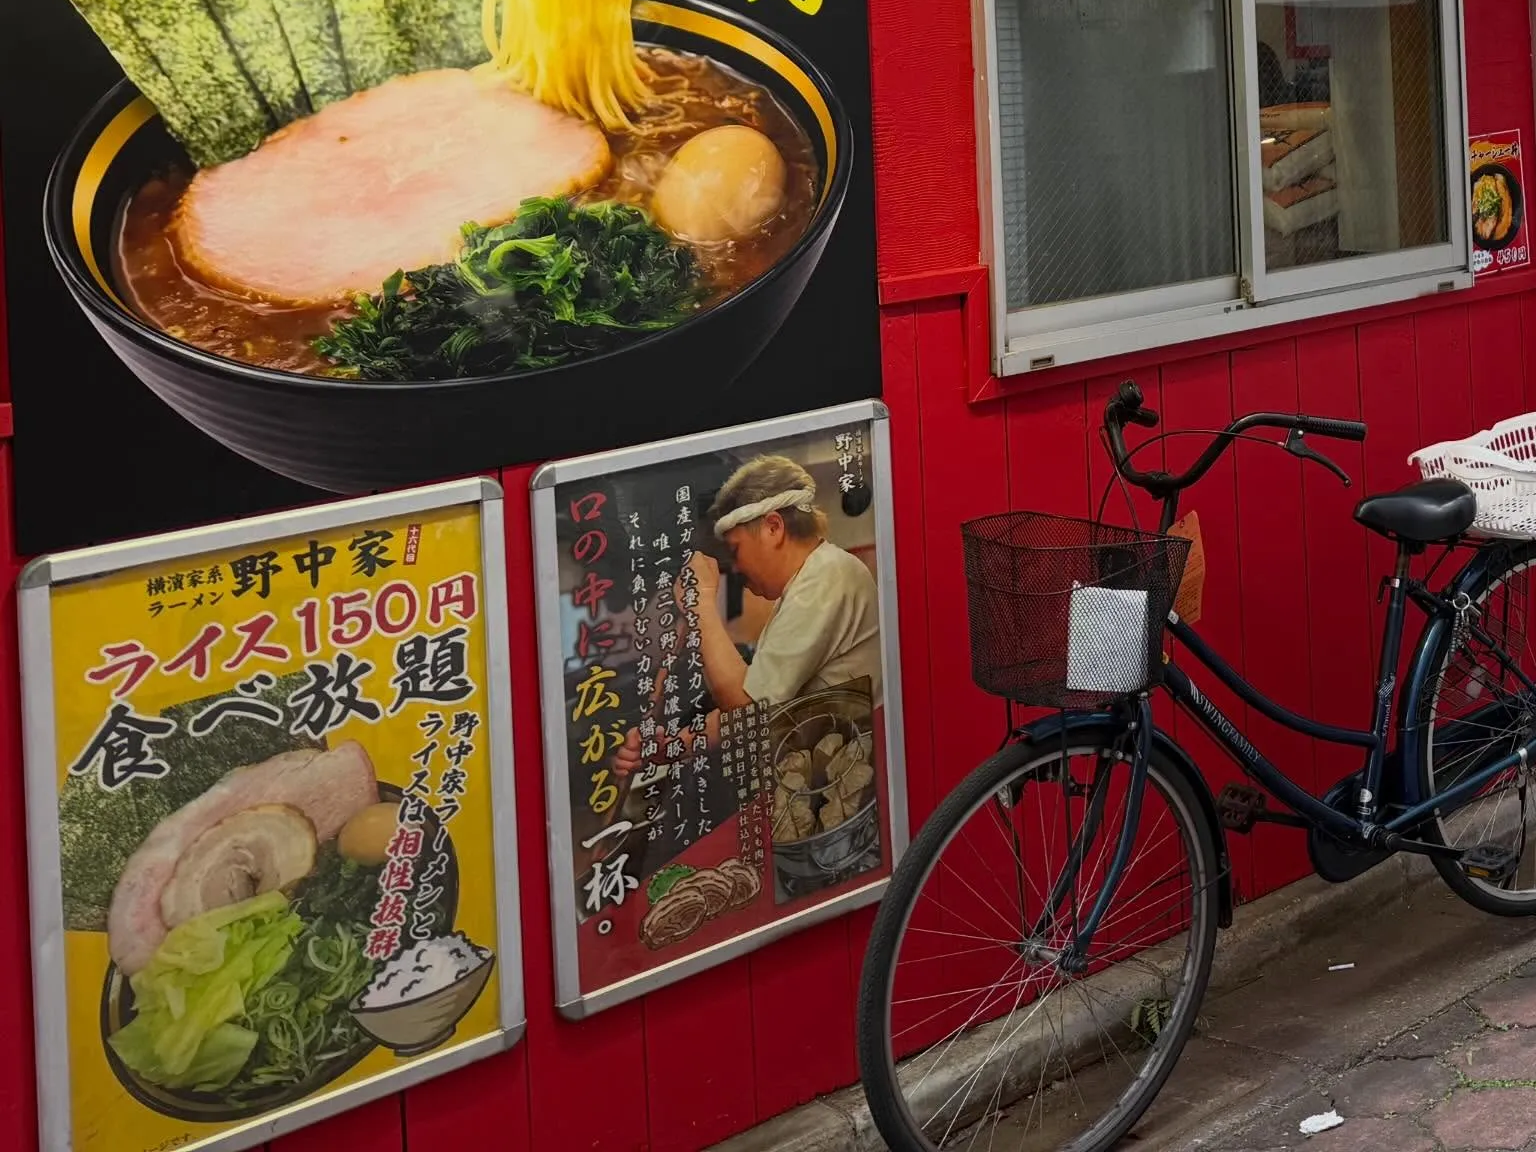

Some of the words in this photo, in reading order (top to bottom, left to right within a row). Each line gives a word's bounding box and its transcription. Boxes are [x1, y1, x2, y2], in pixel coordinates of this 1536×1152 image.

[835, 432, 856, 493] 野中家
[146, 569, 225, 598] 横濱家系
[230, 530, 398, 600] 野中家
[406, 526, 420, 563] 十六代目
[87, 574, 479, 698] ライス150円
[148, 590, 224, 618] ラーメン
[71, 627, 475, 789] 食べ放題
[571, 490, 639, 936] 口の中に広がる一杯。
[365, 713, 442, 960] ライスは相性抜群
[409, 711, 480, 941] 野中家ラーメンと
